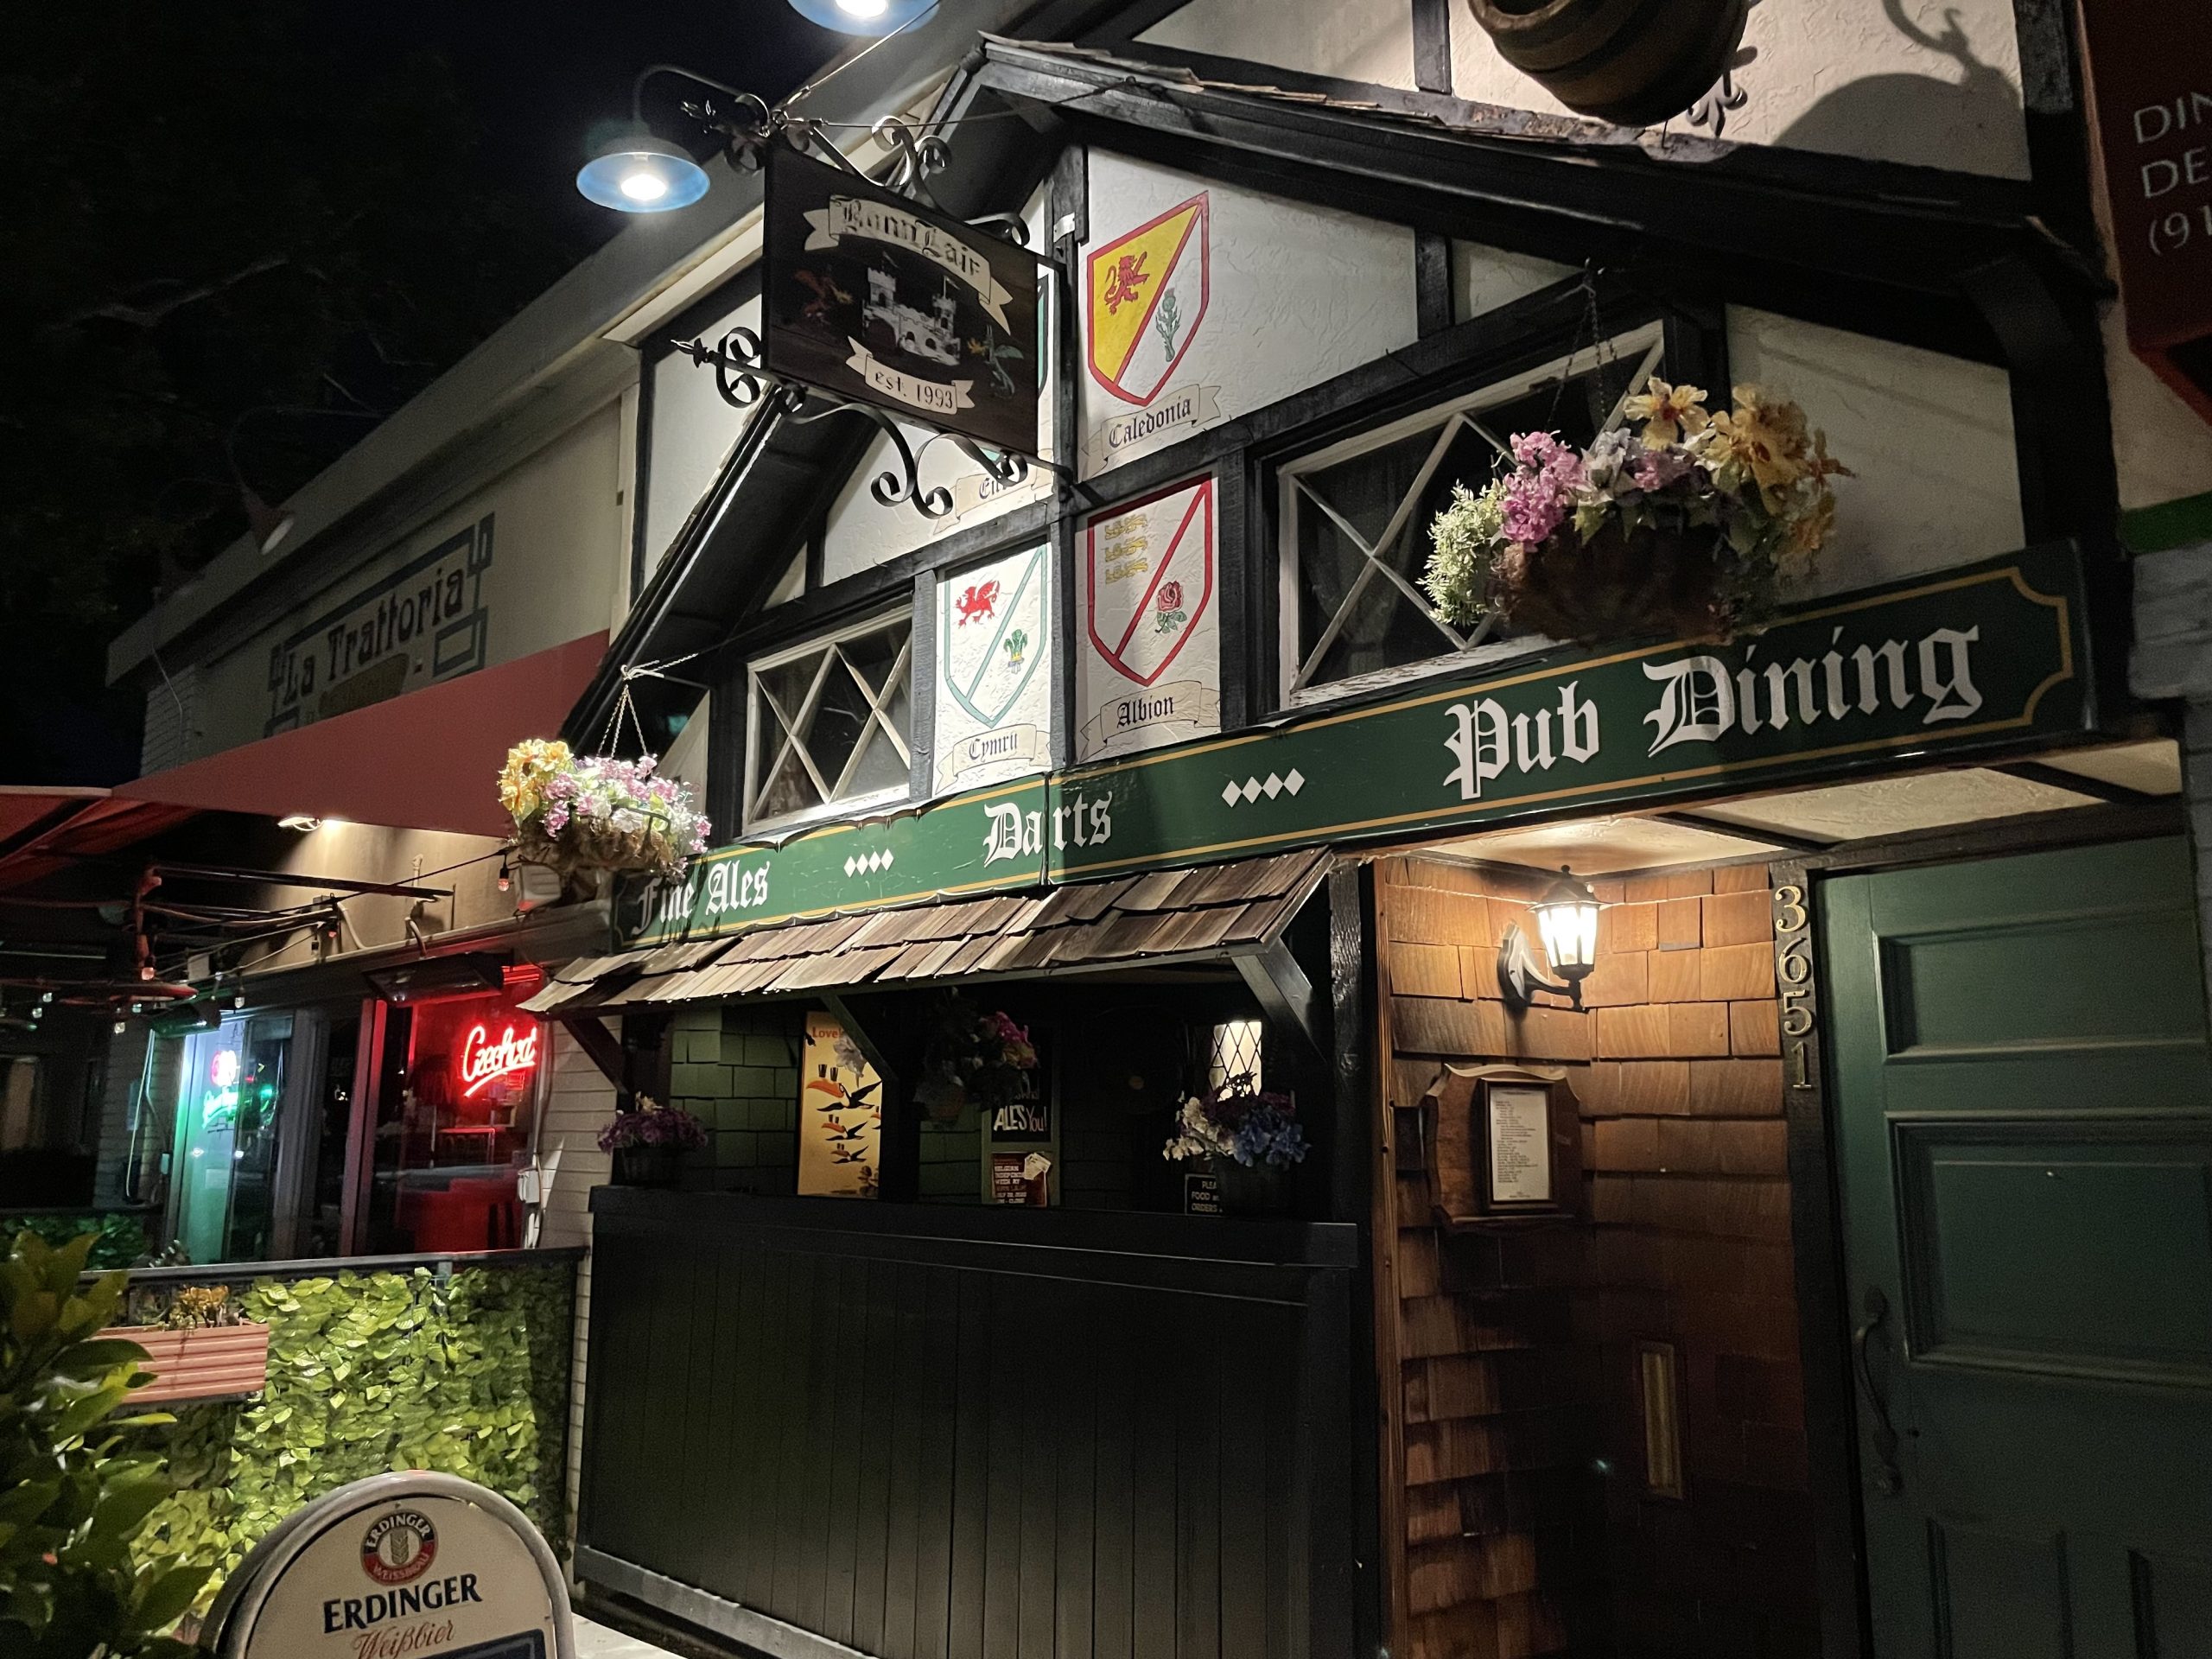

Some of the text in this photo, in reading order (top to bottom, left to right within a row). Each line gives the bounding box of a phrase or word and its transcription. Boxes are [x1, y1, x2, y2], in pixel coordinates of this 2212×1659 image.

[874, 371, 954, 409] est. 1993
[1108, 395, 1192, 449] Caledonia
[283, 567, 465, 707] La Trattoria
[1116, 695, 1174, 729] Albion
[1442, 625, 1984, 801] Pub Dining
[982, 790, 1114, 868] Darts
[704, 859, 771, 917] Ales
[1774, 884, 1813, 1089] 3651
[993, 1104, 1028, 1133] ALES
[1191, 1191, 1211, 1201] FOOD
[365, 1513, 431, 1548] ERDINGER
[323, 1573, 484, 1634] ERDINGER
